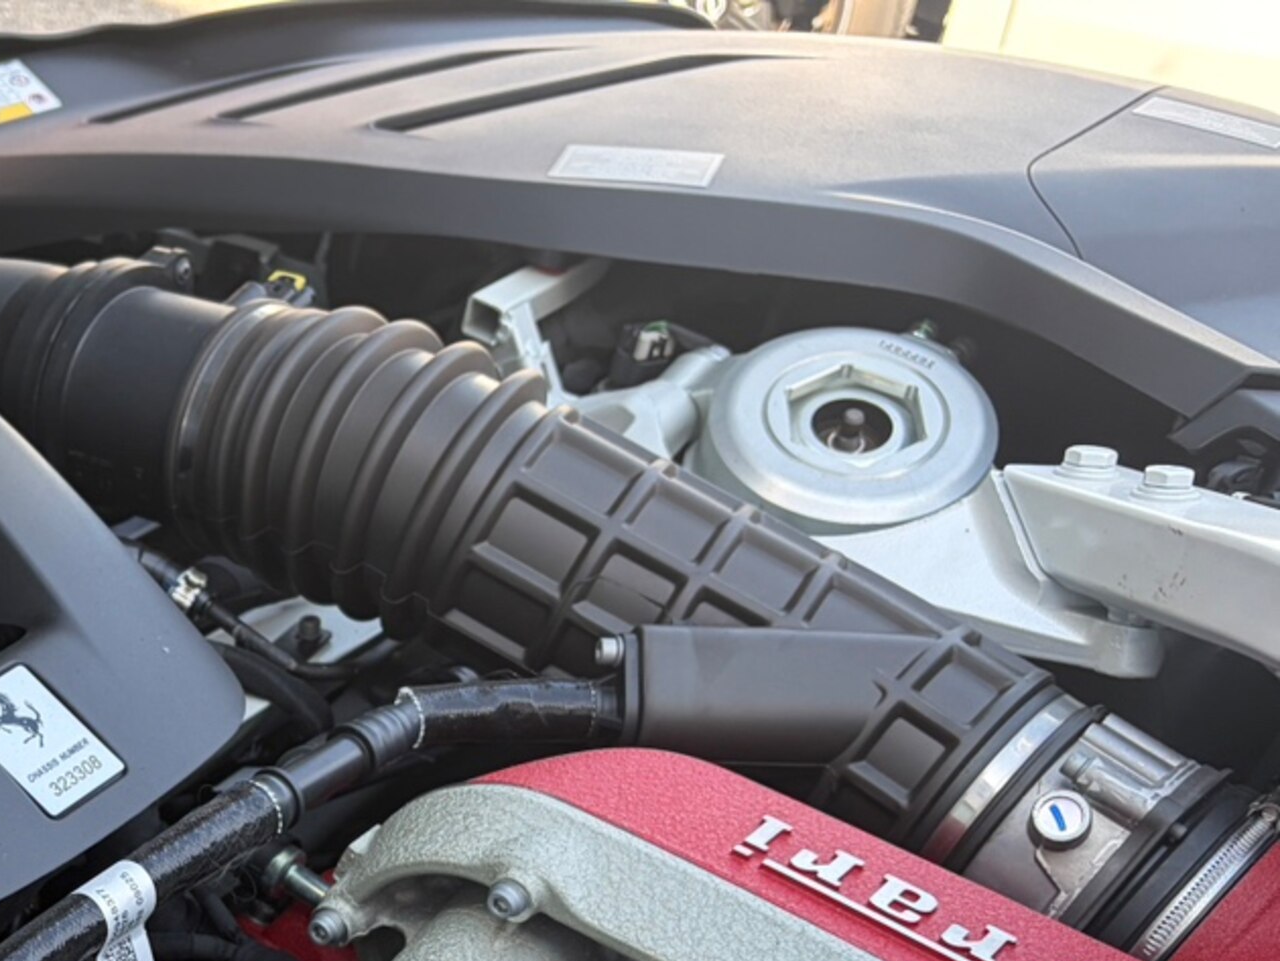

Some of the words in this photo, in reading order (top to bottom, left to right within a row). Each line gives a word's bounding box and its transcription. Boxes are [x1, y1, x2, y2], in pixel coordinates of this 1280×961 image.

[26, 758, 60, 783] CHASSIS
[58, 737, 90, 761] NUMBER
[48, 754, 103, 797] 323308
